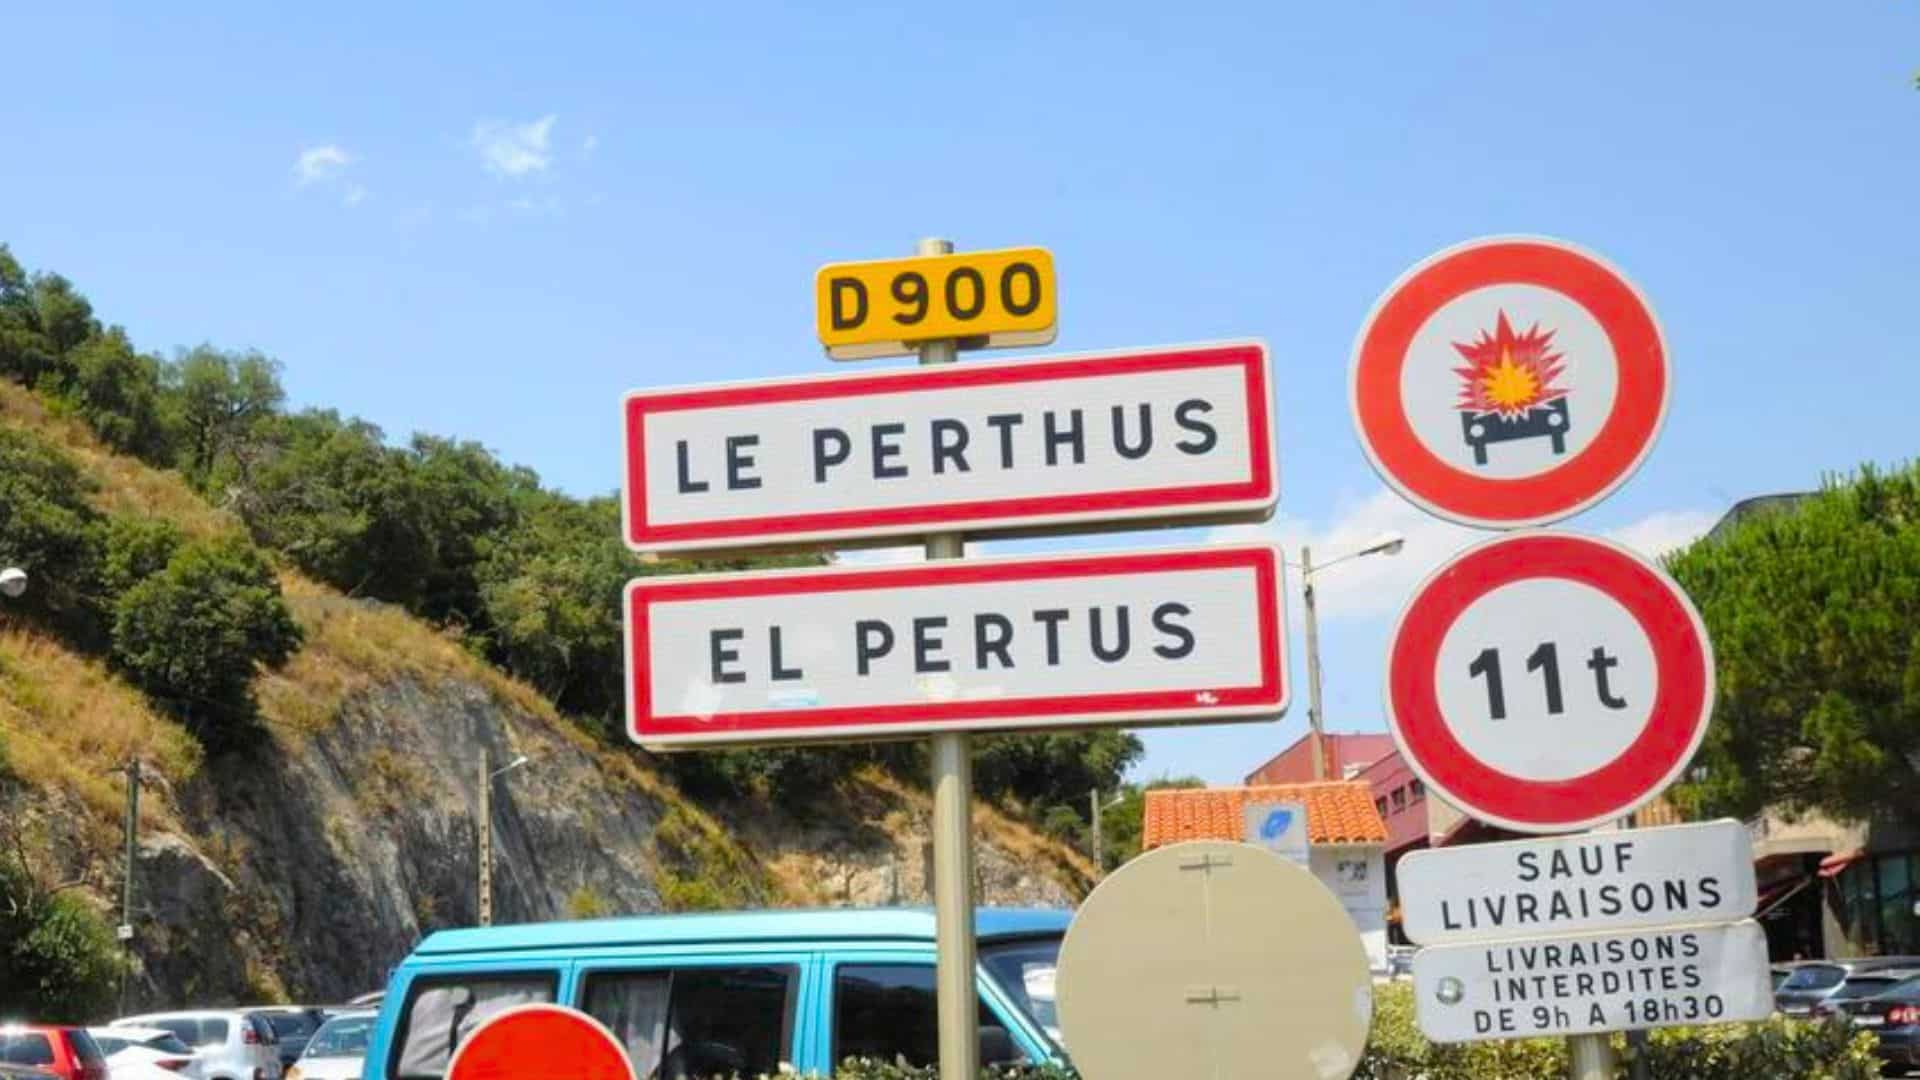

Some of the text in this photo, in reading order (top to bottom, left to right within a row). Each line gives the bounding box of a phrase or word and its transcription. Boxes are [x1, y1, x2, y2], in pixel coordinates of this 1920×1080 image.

[830, 262, 1041, 331] D 900
[676, 399, 1218, 494] LE PERTHUS
[710, 602, 1195, 684] EL PERTUS
[1517, 841, 1634, 882] SAUF
[1441, 876, 1722, 931] LIVRAISONS
[1485, 932, 1700, 973] LIVRAISONS
[1493, 963, 1702, 1002] INTERDITES
[1473, 993, 1724, 1034] DE 9h A 18h30
